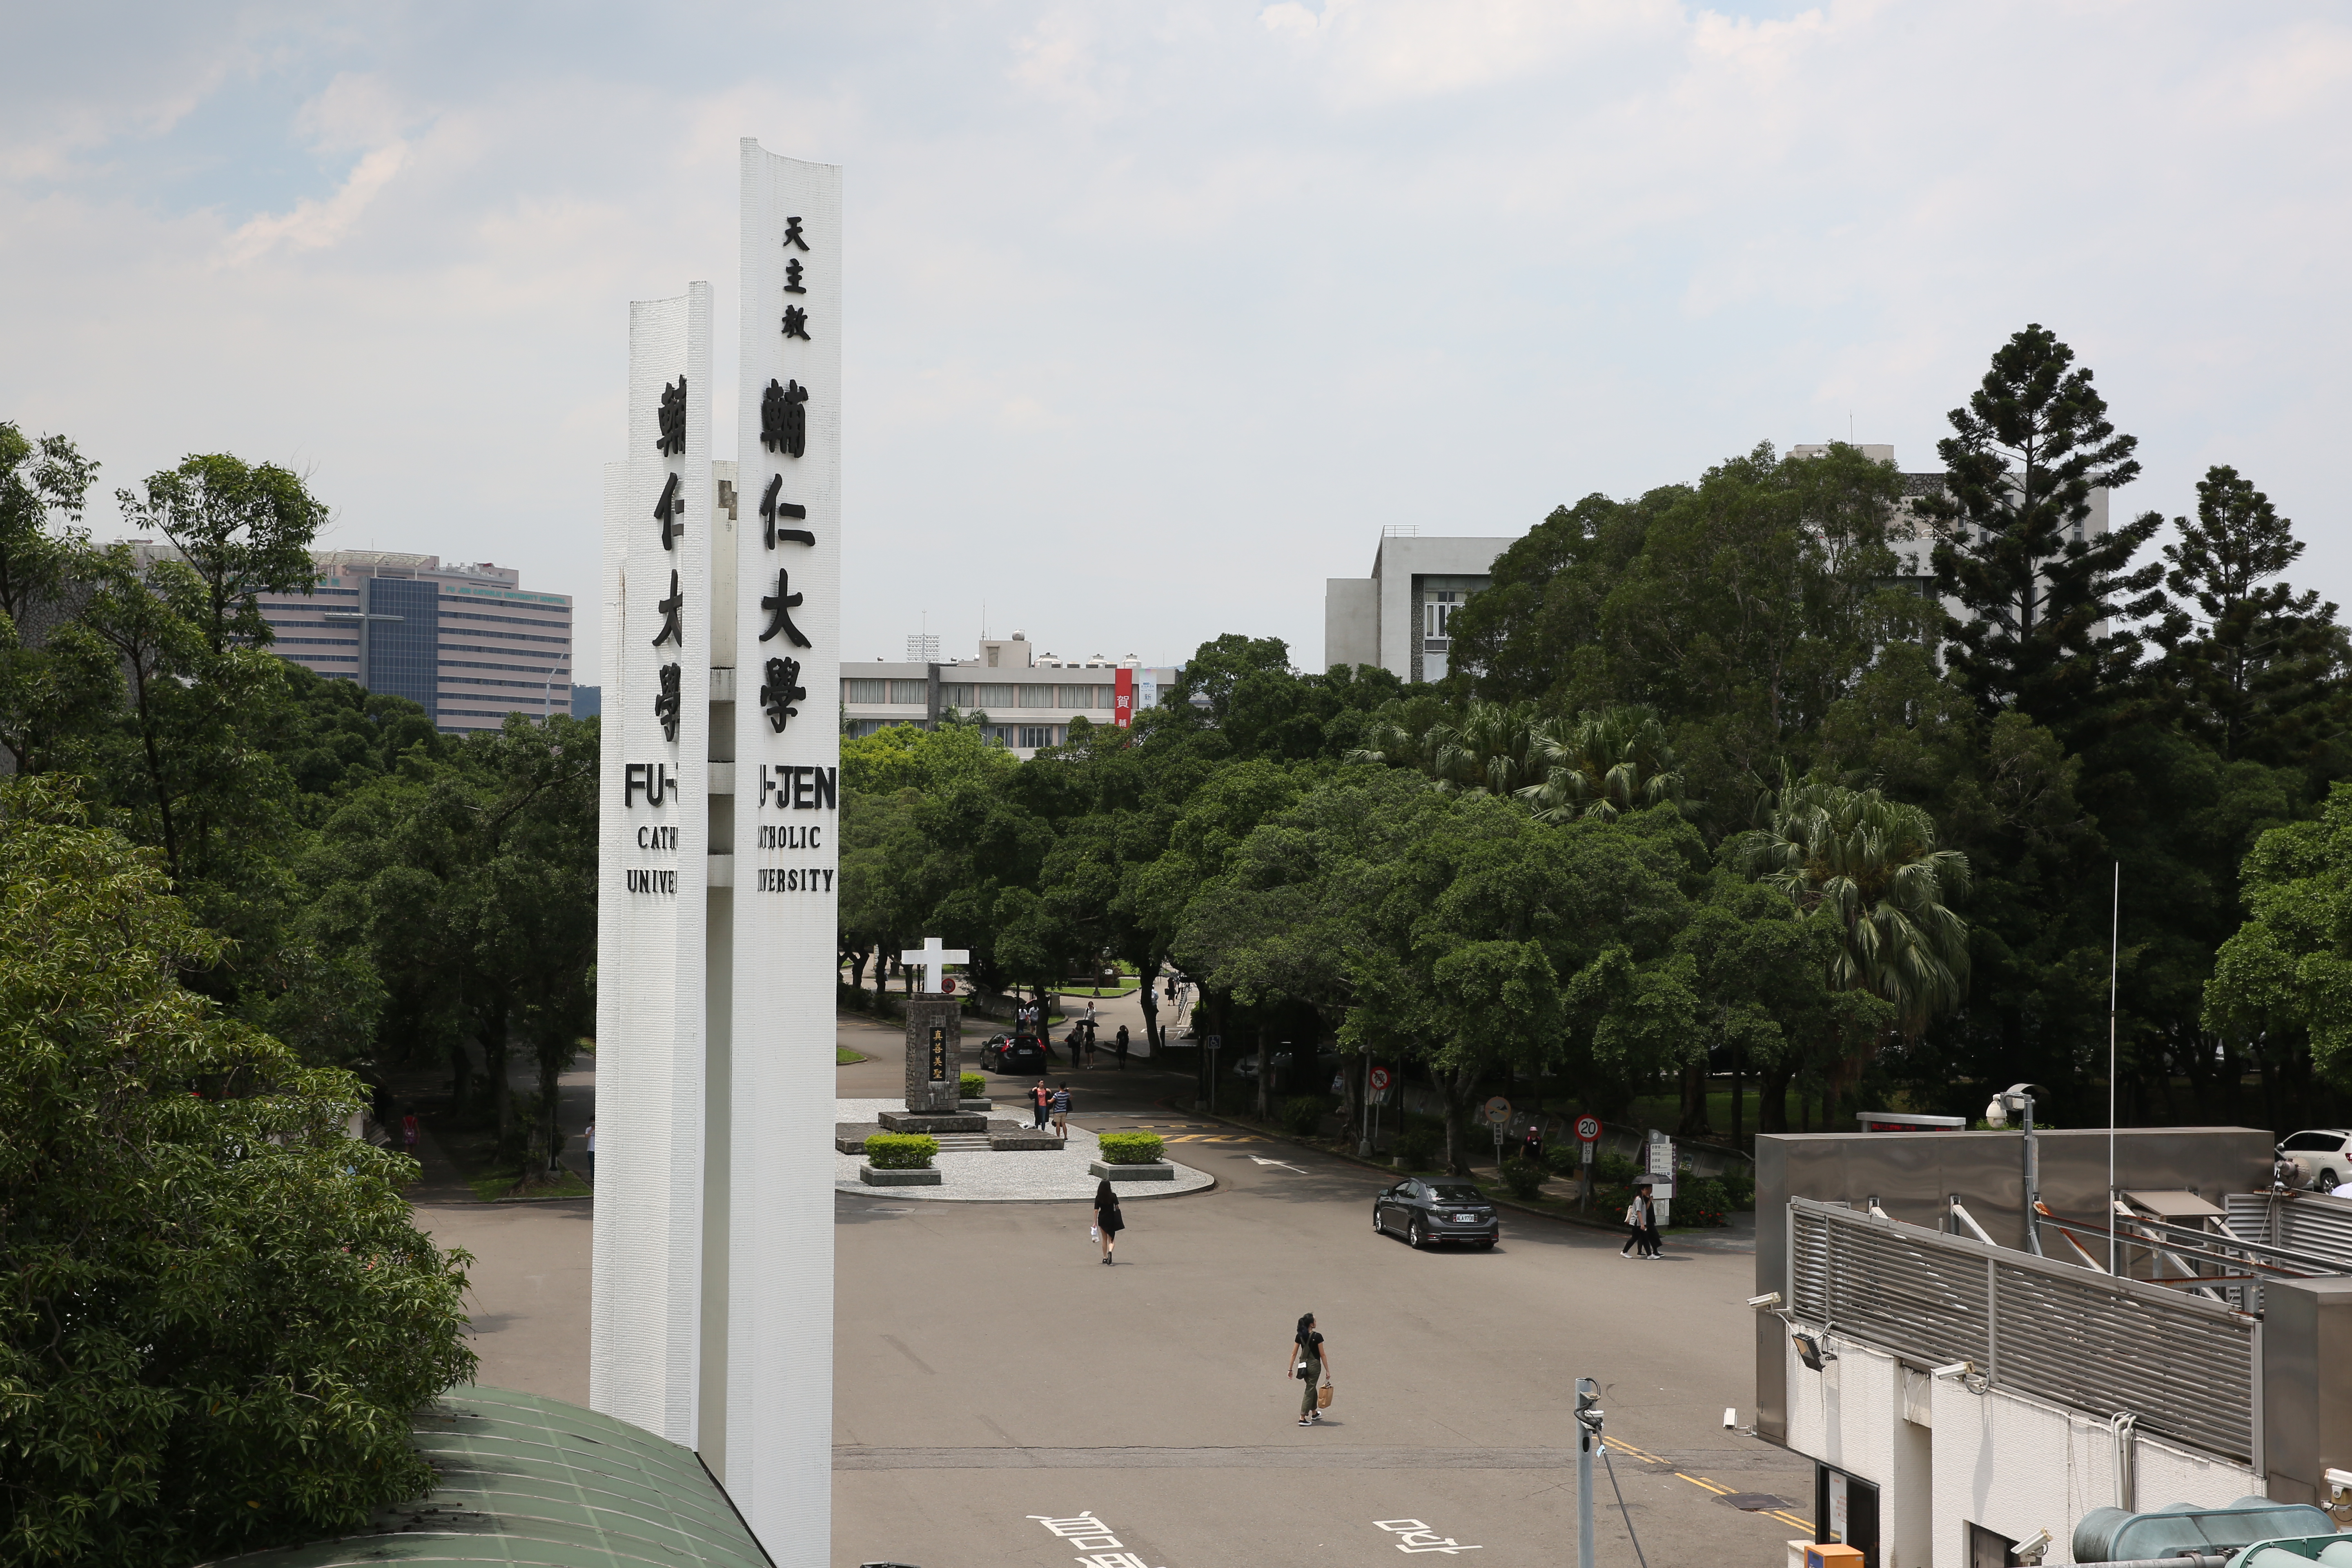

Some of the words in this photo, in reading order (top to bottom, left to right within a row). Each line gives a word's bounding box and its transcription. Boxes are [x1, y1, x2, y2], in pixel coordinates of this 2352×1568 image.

[782, 216, 811, 341] 天主教
[759, 378, 816, 733] 輔仁大學
[473, 588, 502, 597] CATHOLIC
[504, 591, 538, 601] UNIVERSITY
[540, 596, 566, 604] HOSPITAL
[1117, 695, 1129, 708] 賀
[625, 763, 678, 807] FU-
[760, 764, 836, 809] U-JEN
[638, 826, 678, 850] CATH
[758, 825, 821, 849] ATHOLIC
[627, 870, 677, 893] UNIVE
[933, 1030, 943, 1079] 真善美聖
[1374, 1072, 1385, 1084] 停
[1581, 1121, 1596, 1135] 20
